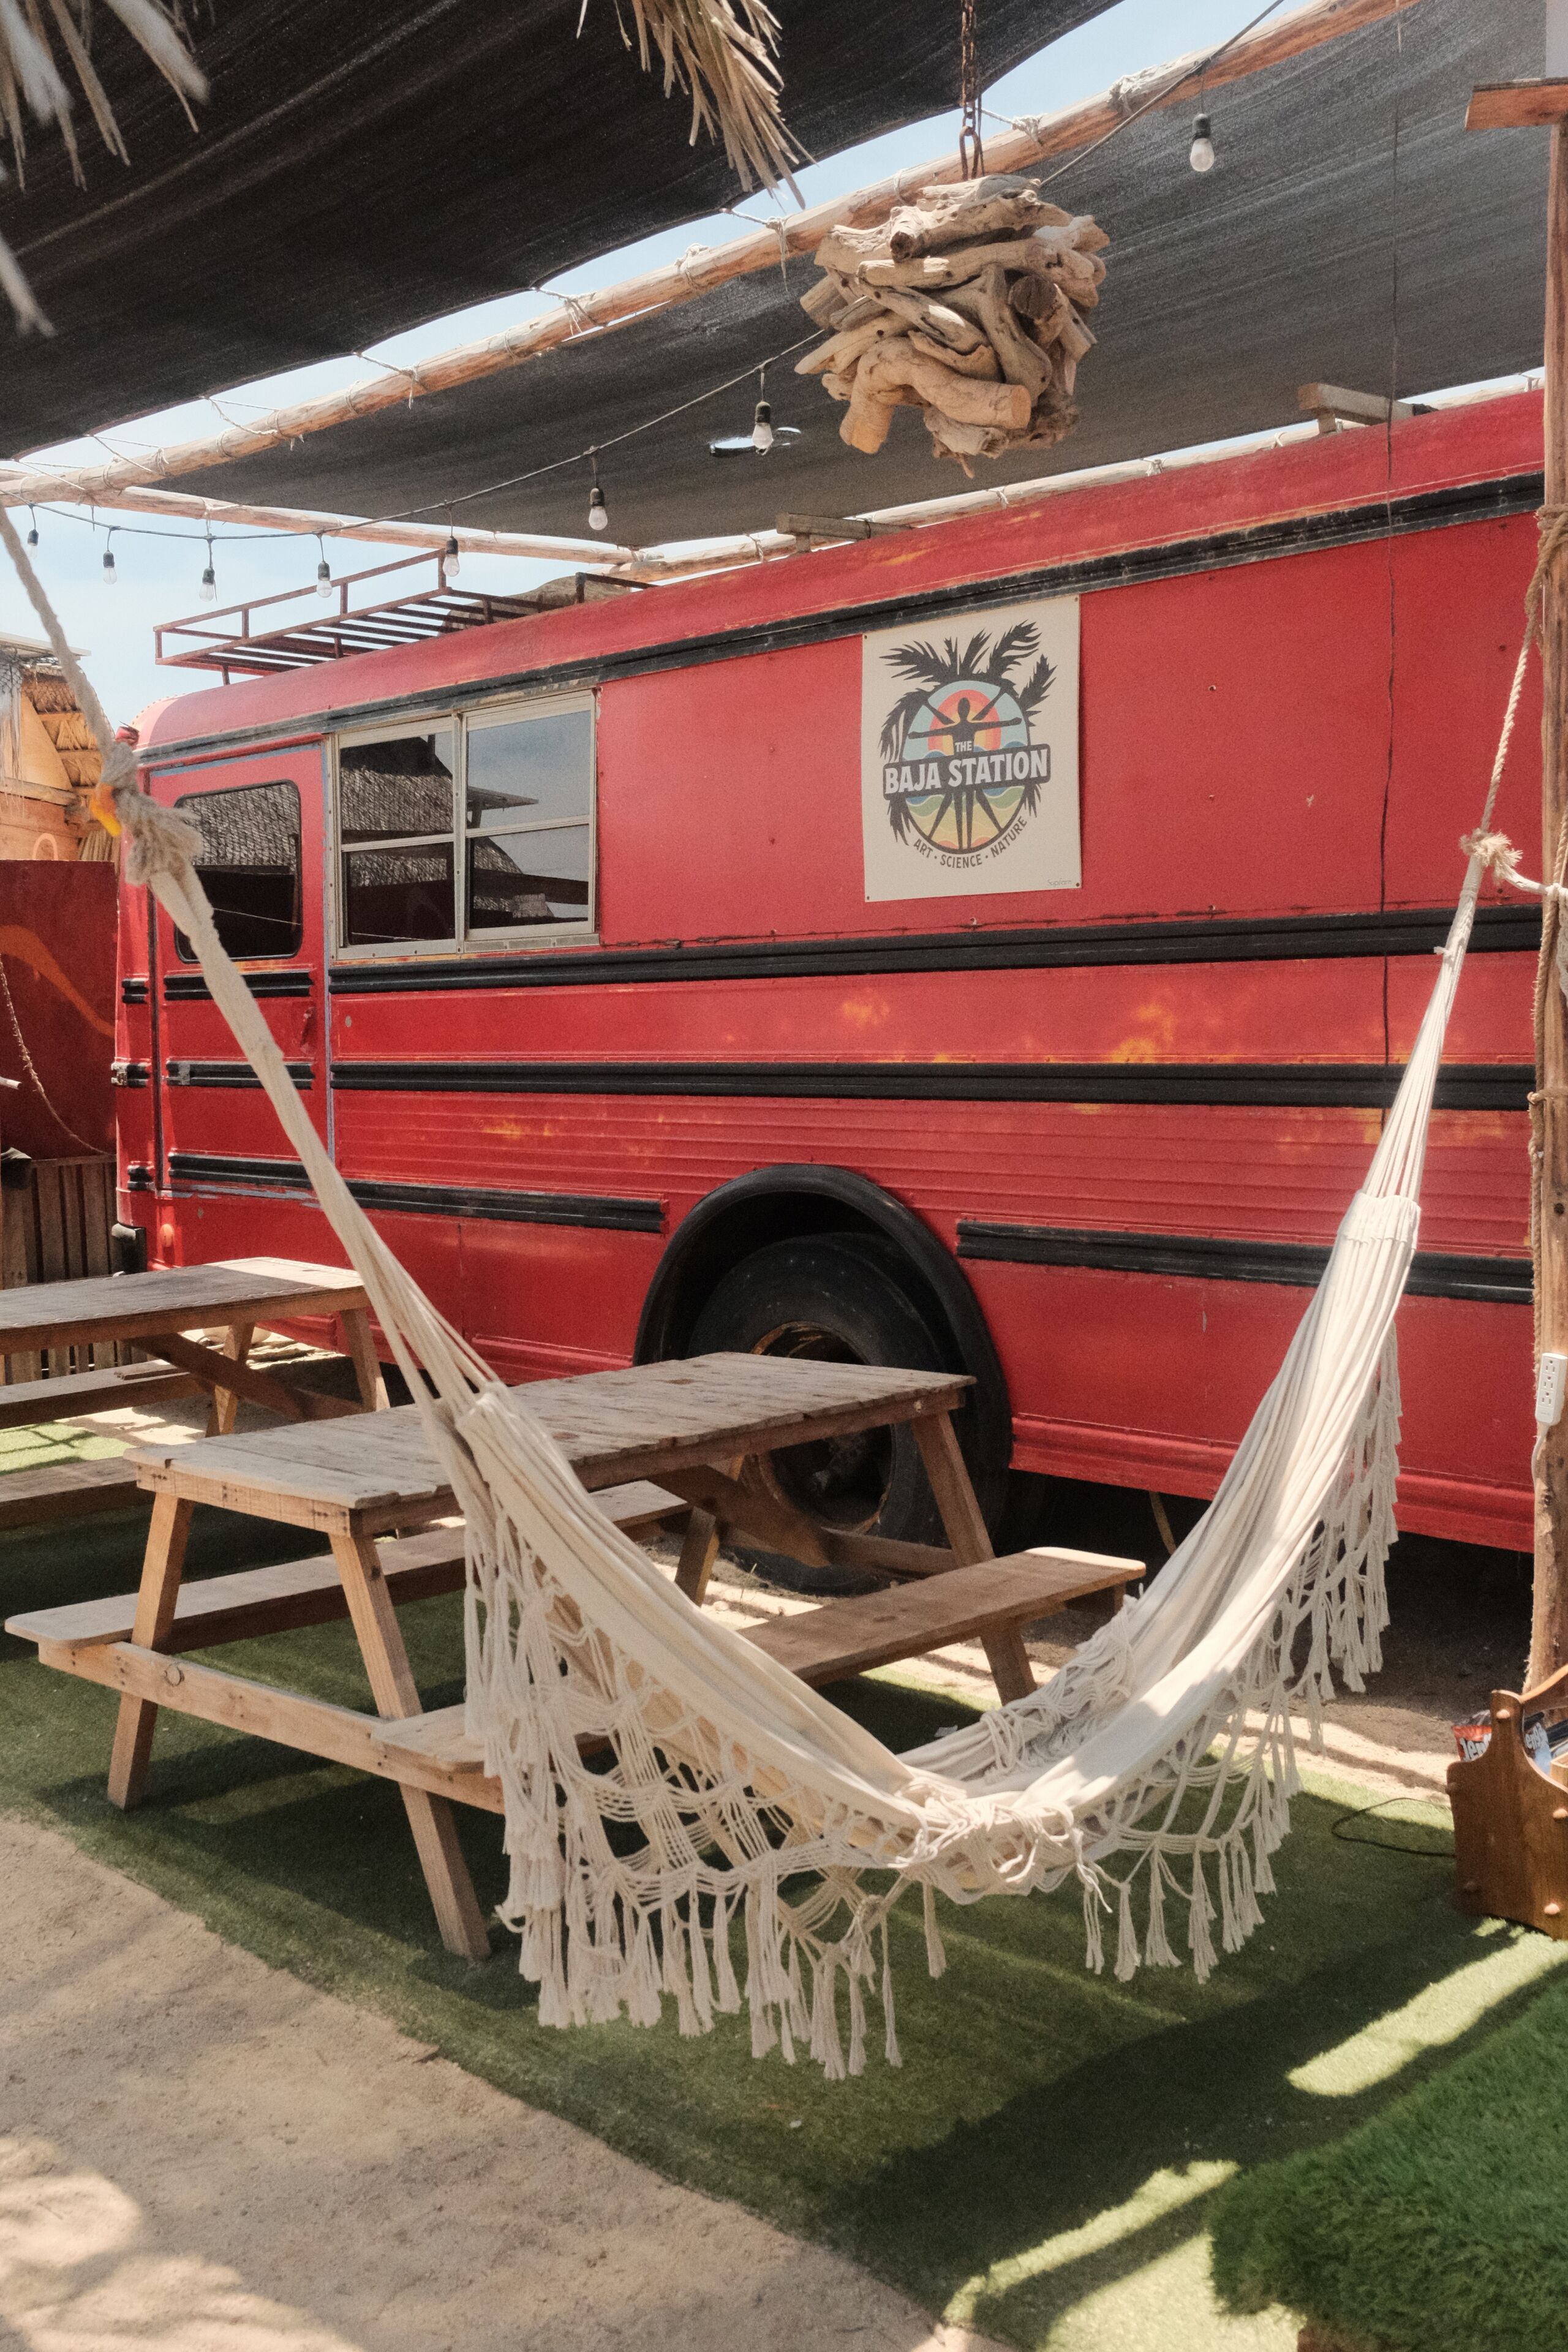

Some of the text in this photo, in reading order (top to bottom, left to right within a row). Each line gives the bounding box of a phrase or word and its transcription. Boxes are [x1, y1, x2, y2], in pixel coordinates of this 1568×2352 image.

[954, 740, 973, 752] THE
[884, 748, 1048, 794] BAJA STATION
[913, 815, 1027, 869] ART SCIENCE NATURE
